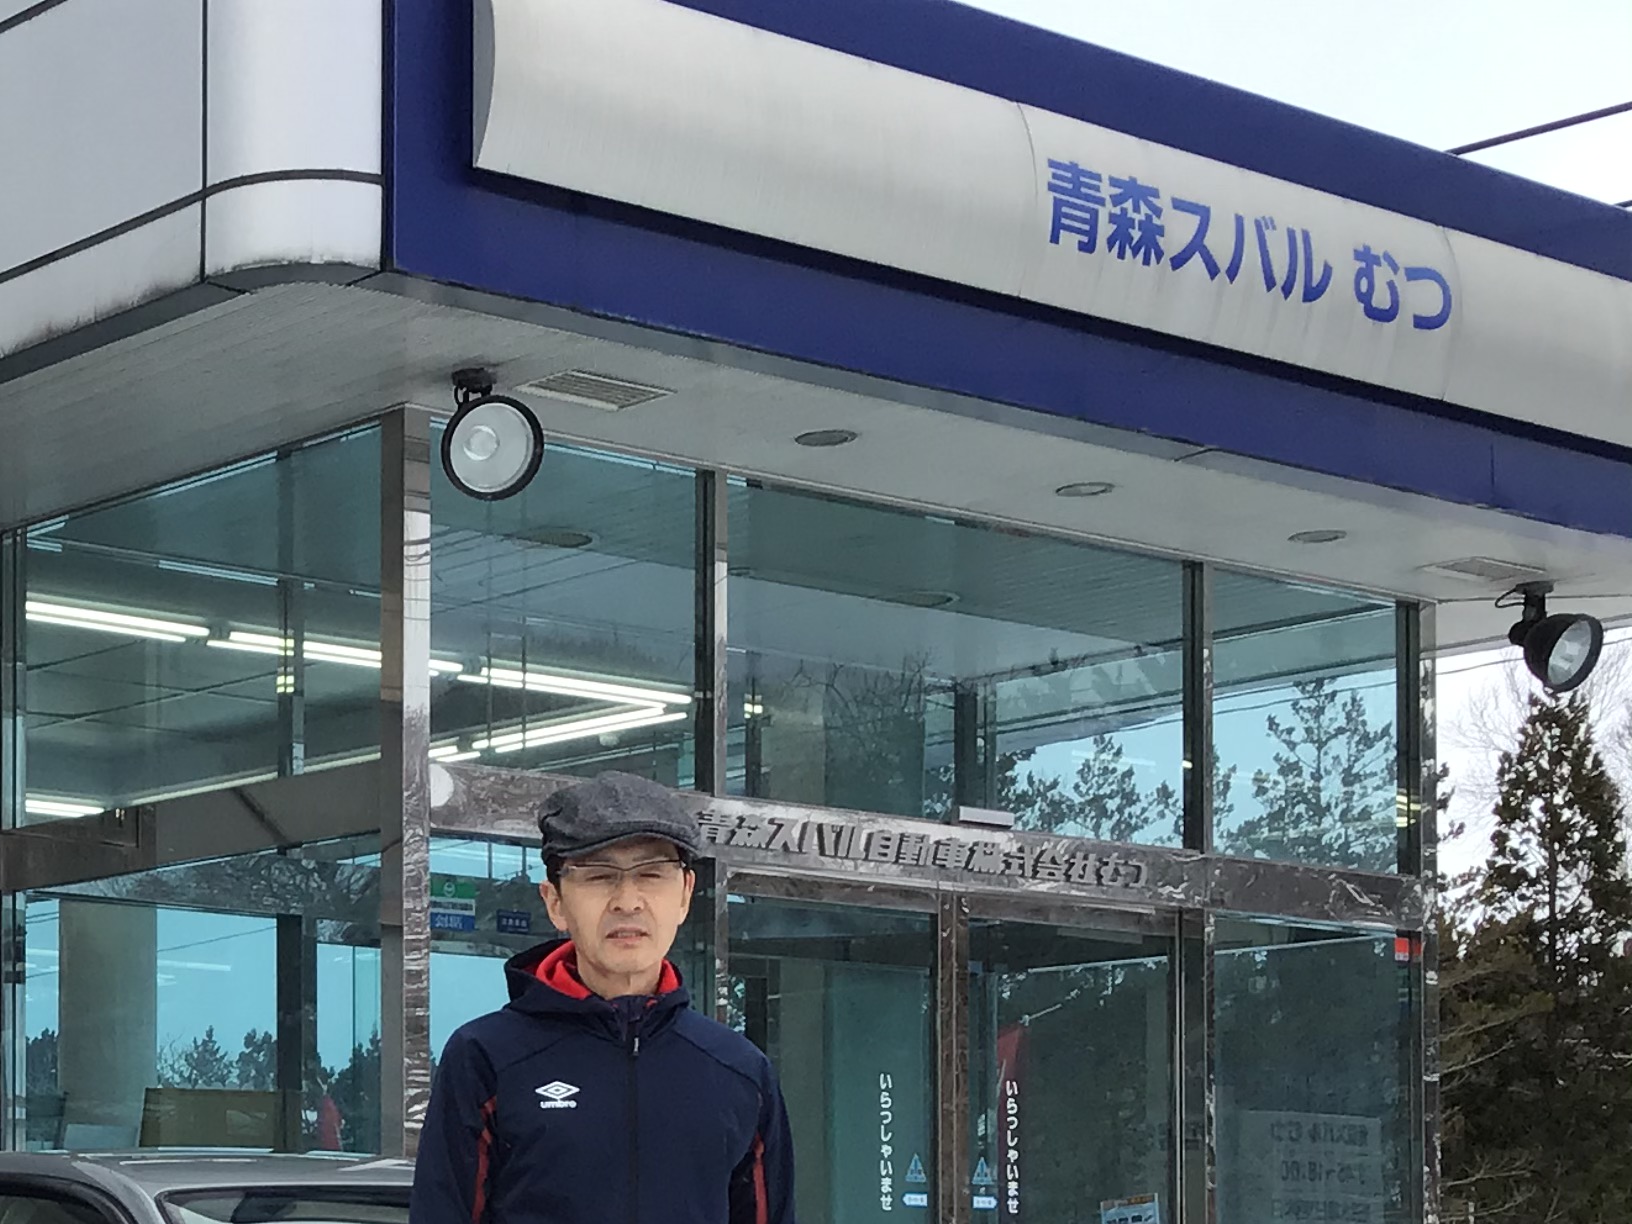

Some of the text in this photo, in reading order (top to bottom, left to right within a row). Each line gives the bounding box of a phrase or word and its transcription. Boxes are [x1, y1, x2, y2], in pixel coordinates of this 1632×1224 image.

[1046, 156, 1453, 331] 青森スバル むつ
[879, 1072, 894, 1212] いらっしゃいませ
[1005, 1080, 1020, 1214] いらっしゃいませ
